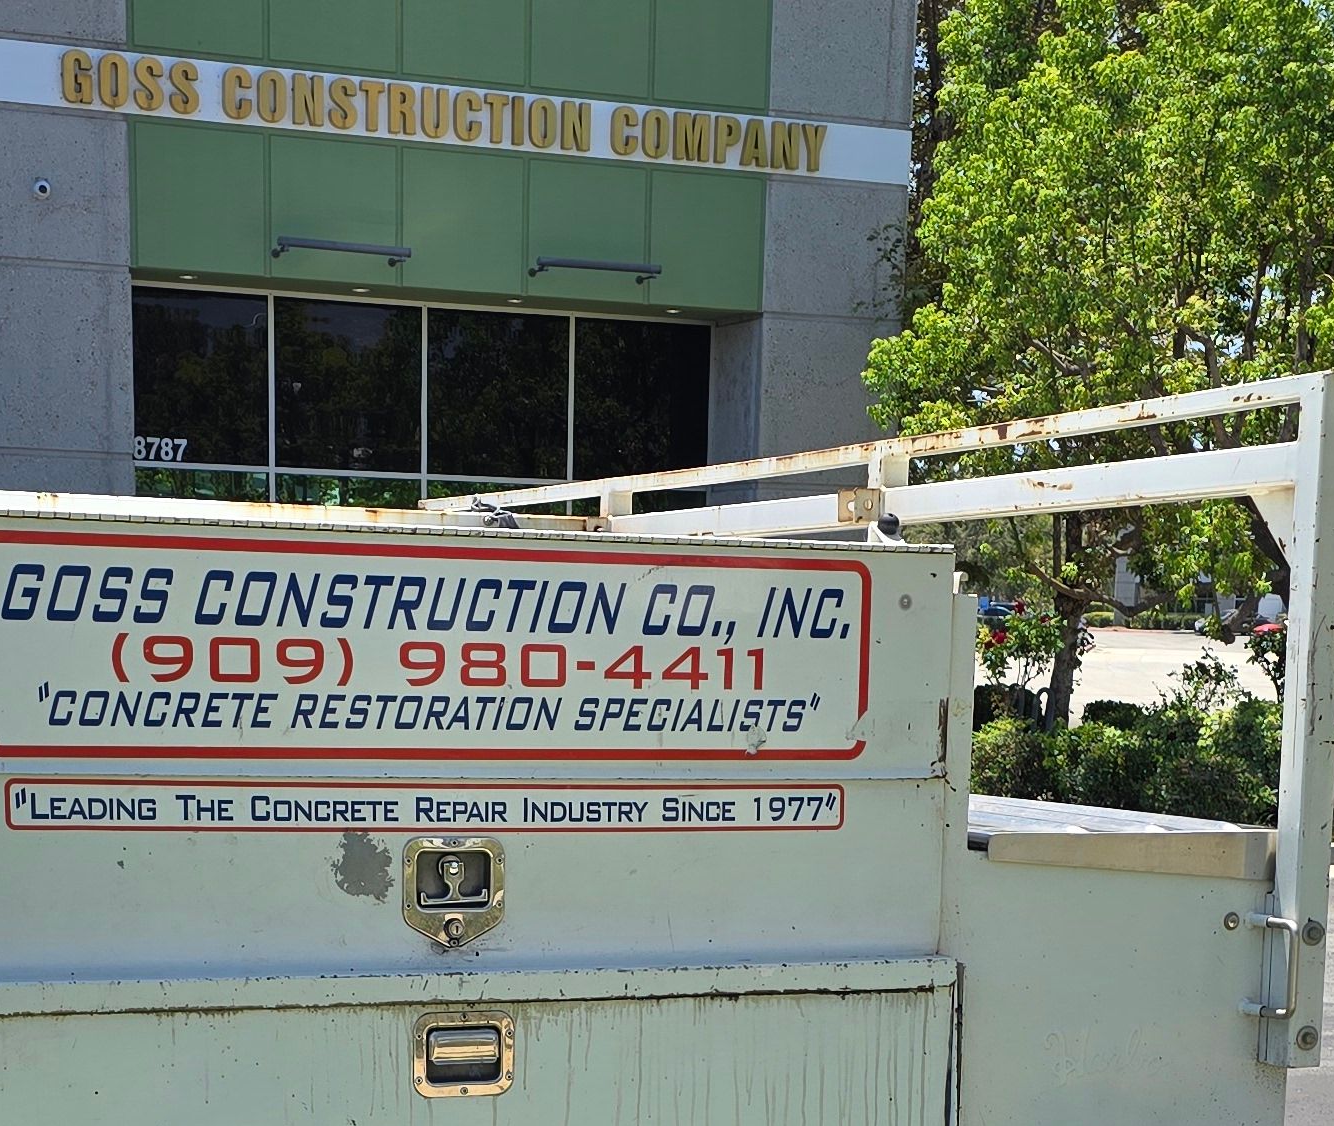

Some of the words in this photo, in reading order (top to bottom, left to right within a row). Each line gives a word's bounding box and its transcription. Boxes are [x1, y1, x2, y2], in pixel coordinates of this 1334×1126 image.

[61, 50, 200, 115] GOSS
[221, 67, 592, 152] CONSTRUCTION
[610, 106, 827, 172] COMPANY
[133, 436, 188, 461] 8787
[1, 563, 173, 624] GOSS
[194, 569, 627, 635] CONSTRUCTION
[641, 584, 737, 645] CO.,
[756, 587, 850, 640] INC.
[111, 632, 354, 686] (909)
[399, 640, 765, 691] 980-4411
[38, 681, 278, 729] "CONCRETE
[290, 693, 563, 731] RESTORATION
[573, 692, 821, 732] SPECIALISTS"
[15, 787, 157, 821] "LEADING
[175, 794, 234, 822] THE
[250, 795, 399, 823] CONCRETE
[414, 796, 508, 823] REPAIR
[523, 797, 649, 824] INDUSTRY
[661, 796, 736, 823] SINCE
[753, 792, 836, 823] 1977"
